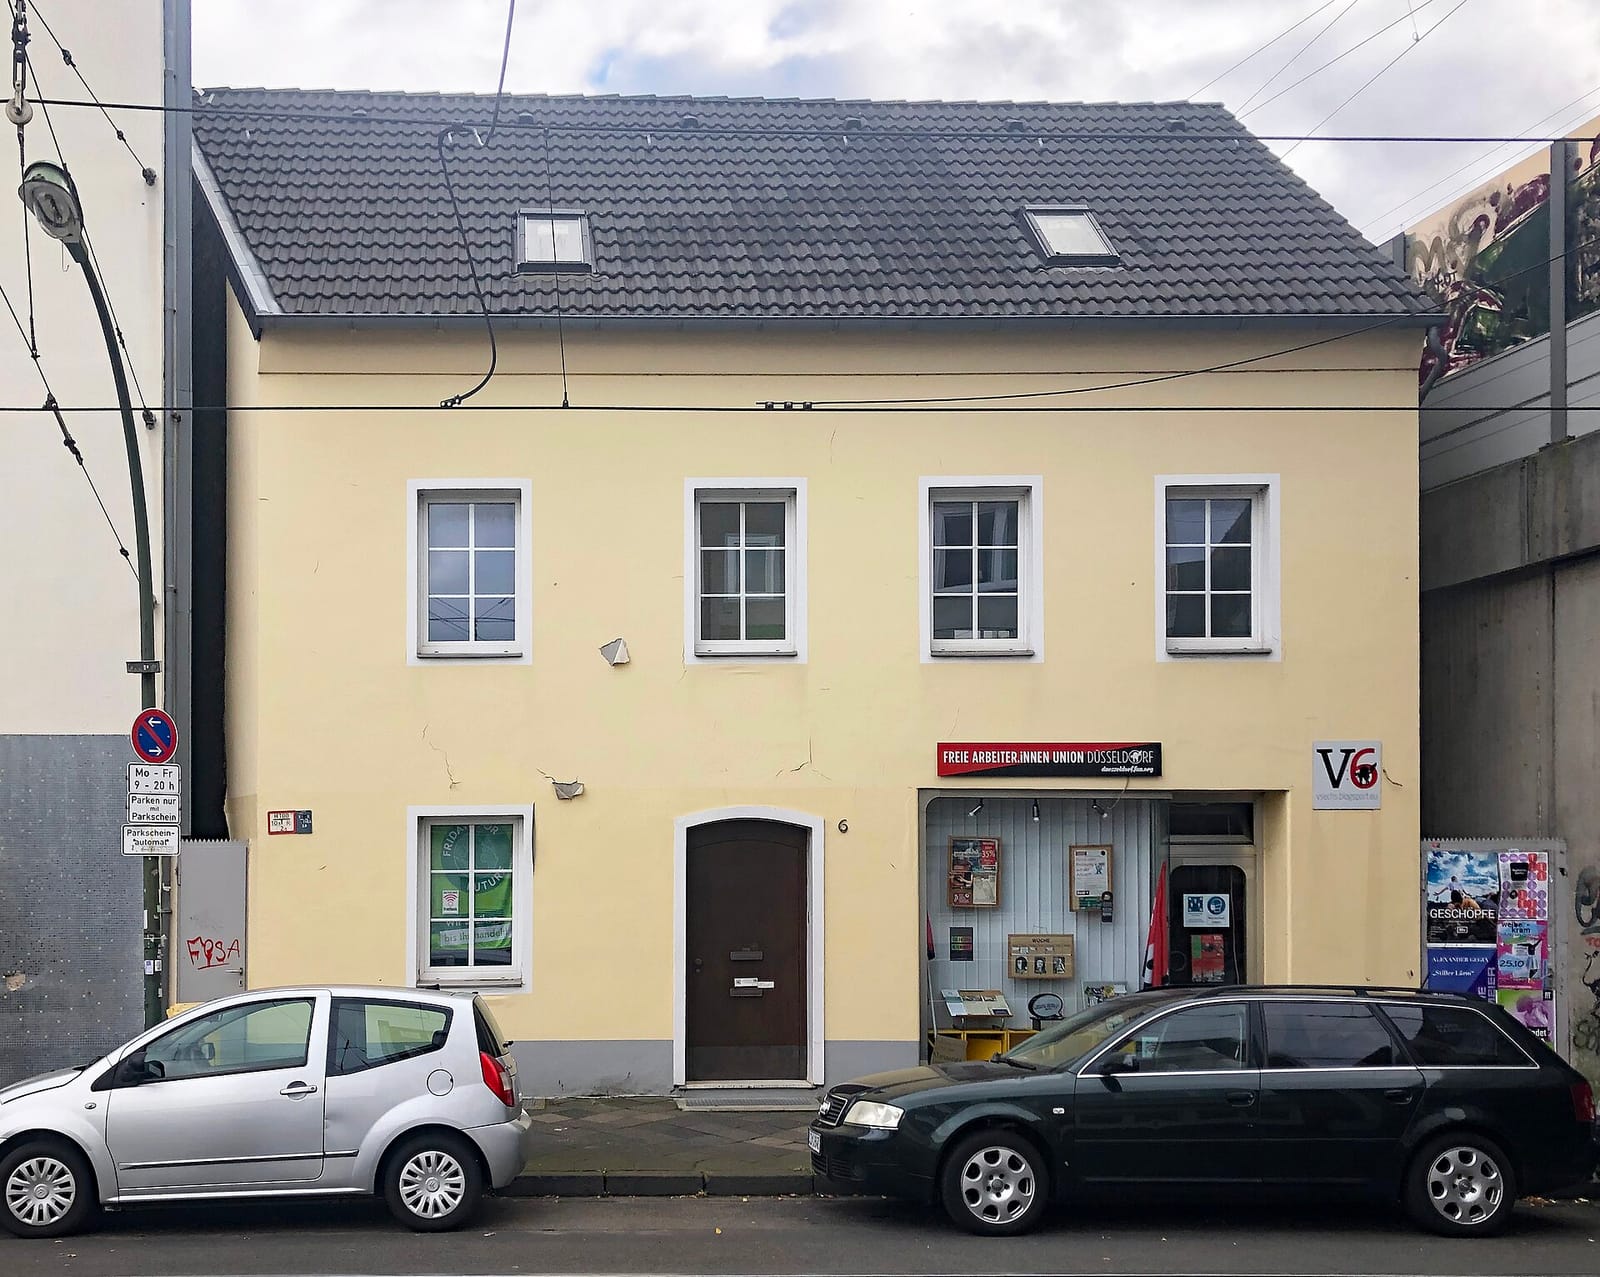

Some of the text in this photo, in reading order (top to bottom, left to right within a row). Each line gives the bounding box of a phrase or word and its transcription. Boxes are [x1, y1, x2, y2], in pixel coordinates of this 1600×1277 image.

[943, 750, 969, 764] FREIE
[1052, 750, 1084, 764] UNION
[135, 767, 150, 778] Mo
[162, 768, 173, 778] Fr
[1316, 748, 1378, 789] V6
[134, 780, 140, 790] 9
[153, 780, 165, 790] 20
[168, 781, 175, 791] h
[131, 795, 177, 806] Parken nur
[131, 812, 177, 821] Parkschein
[837, 818, 849, 834] 6
[126, 829, 175, 837] Parkschein-
[442, 824, 468, 857] FRIDA
[1429, 906, 1496, 919] GESCHÖPFE
